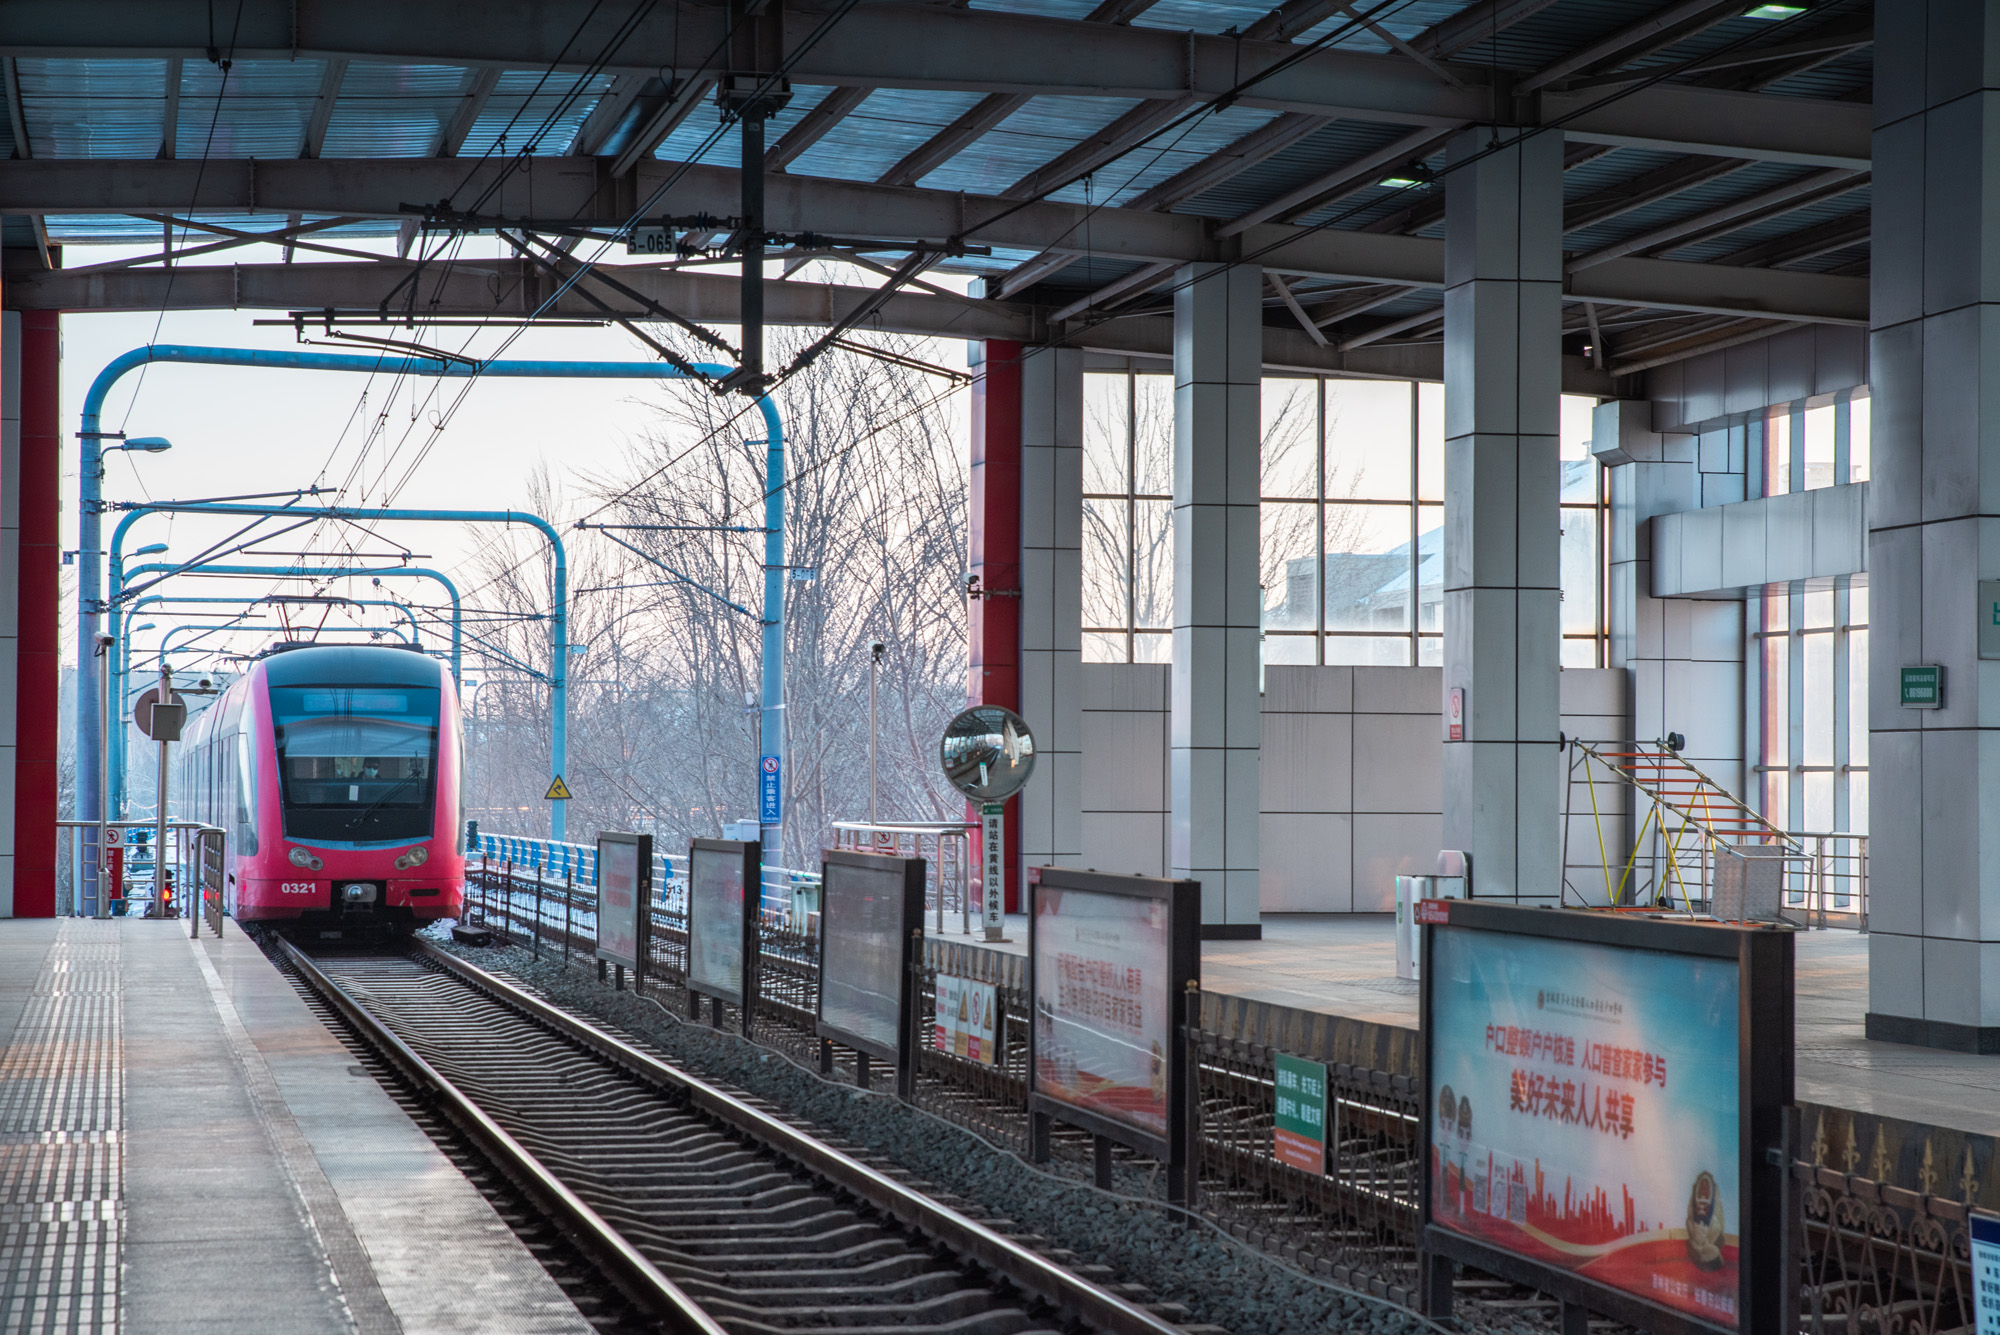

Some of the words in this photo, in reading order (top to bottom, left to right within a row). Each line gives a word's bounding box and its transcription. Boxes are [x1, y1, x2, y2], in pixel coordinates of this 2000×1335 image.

[629, 234, 672, 253] 5-065
[765, 775, 776, 816] 禁止乘客进入
[281, 882, 316, 894] 0321
[988, 818, 999, 922] 请站在黄线以外候车
[1485, 1022, 1575, 1067] 户口整顿户户核准
[1581, 1039, 1667, 1089] 人口普查家家参与
[1509, 1068, 1635, 1140] 美好未来人人共享
